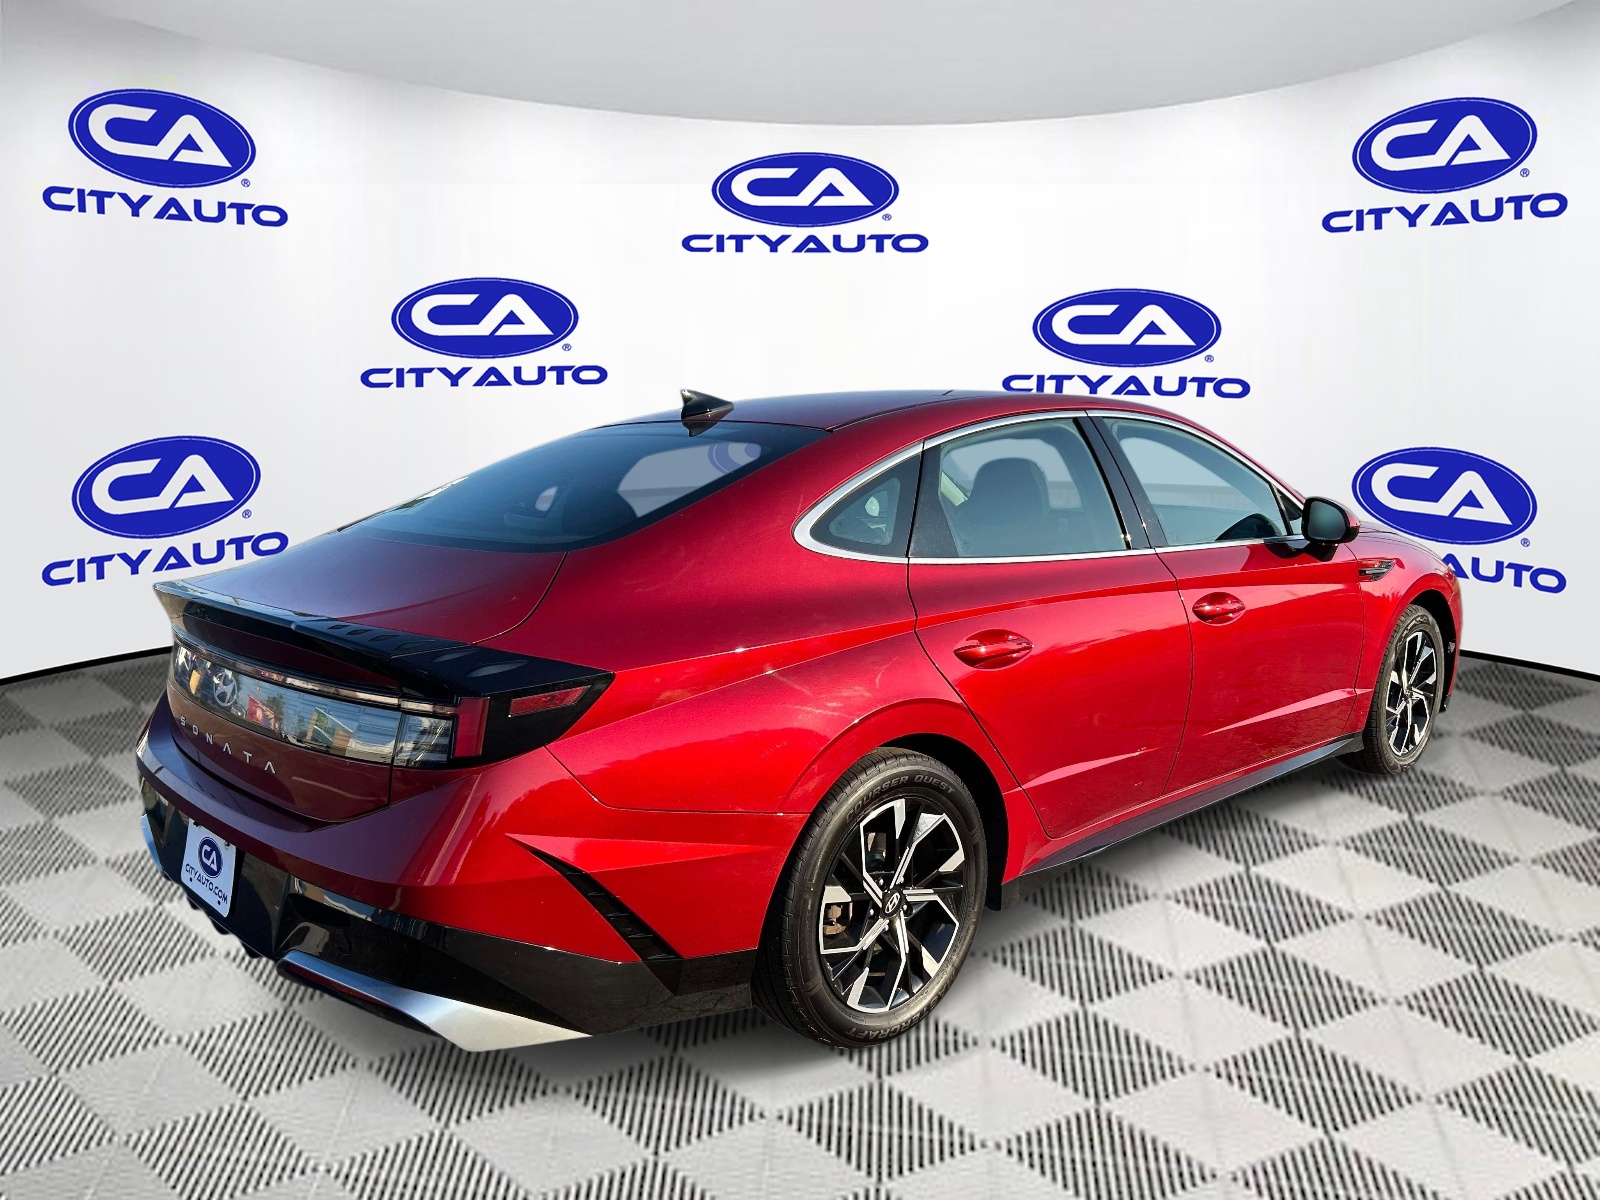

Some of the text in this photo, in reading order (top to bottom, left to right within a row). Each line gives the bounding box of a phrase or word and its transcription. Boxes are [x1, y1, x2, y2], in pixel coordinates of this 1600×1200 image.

[89, 104, 233, 168] CA
[1371, 114, 1511, 172] CA
[730, 167, 874, 207] CA
[411, 293, 554, 337] CA
[1051, 304, 1197, 346] CA
[92, 454, 235, 515] CA
[1371, 462, 1513, 526] CA
[180, 715, 276, 774] SONATA
[846, 774, 957, 823] COURSER QUEST
[201, 844, 219, 873] CA
